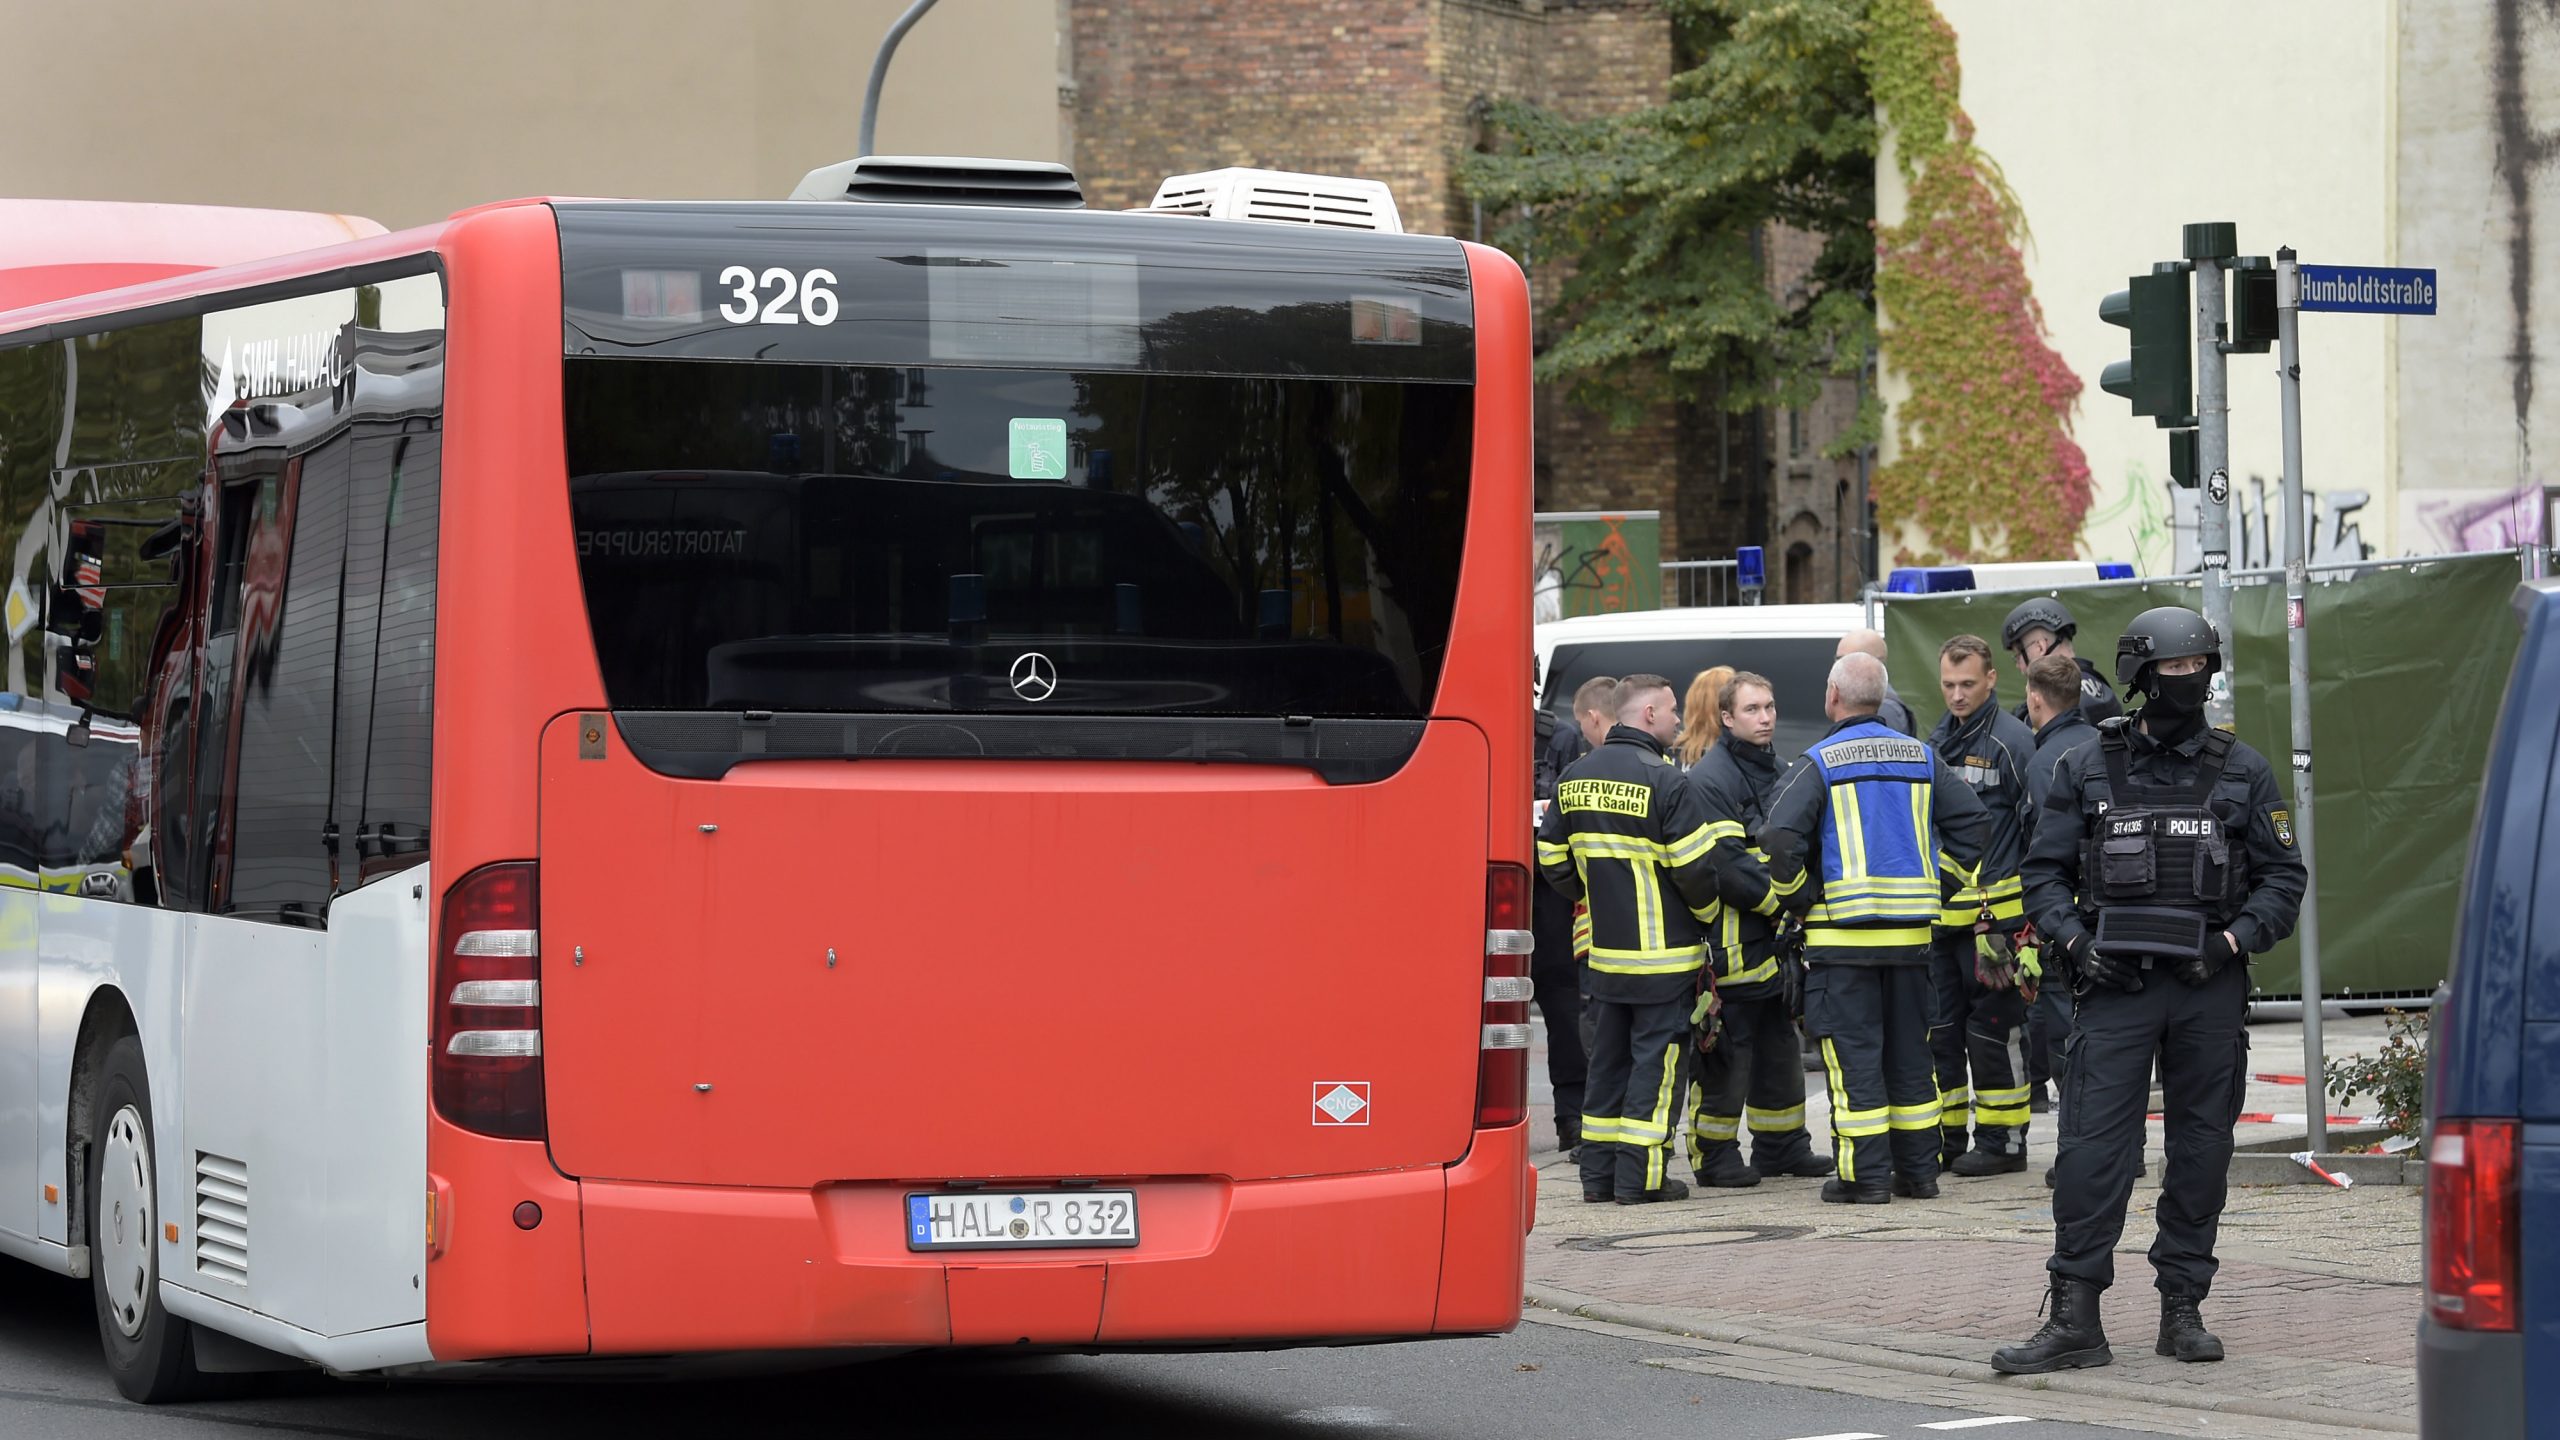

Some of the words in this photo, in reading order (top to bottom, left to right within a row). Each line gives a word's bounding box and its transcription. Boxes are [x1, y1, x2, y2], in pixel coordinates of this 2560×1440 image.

[719, 265, 839, 326] 326
[2301, 272, 2433, 305] Humboldtstraße
[240, 338, 282, 399] SWH.
[286, 327, 342, 393] HAVAG
[1825, 741, 1923, 764] GRUPPENFÜHRER
[1560, 781, 1647, 800] FEUERWEHR
[1562, 795, 1592, 811] HALLE
[1598, 796, 1645, 815] (Saale)
[2113, 822, 2123, 834] ST
[2123, 820, 2142, 833] 41305
[2170, 820, 2212, 835] POLIZEI
[1324, 1097, 1360, 1110] CNG
[934, 1202, 1004, 1238] HAL
[1033, 1201, 1054, 1236] R
[1065, 1200, 1130, 1236] 832
[917, 1224, 925, 1235] D
